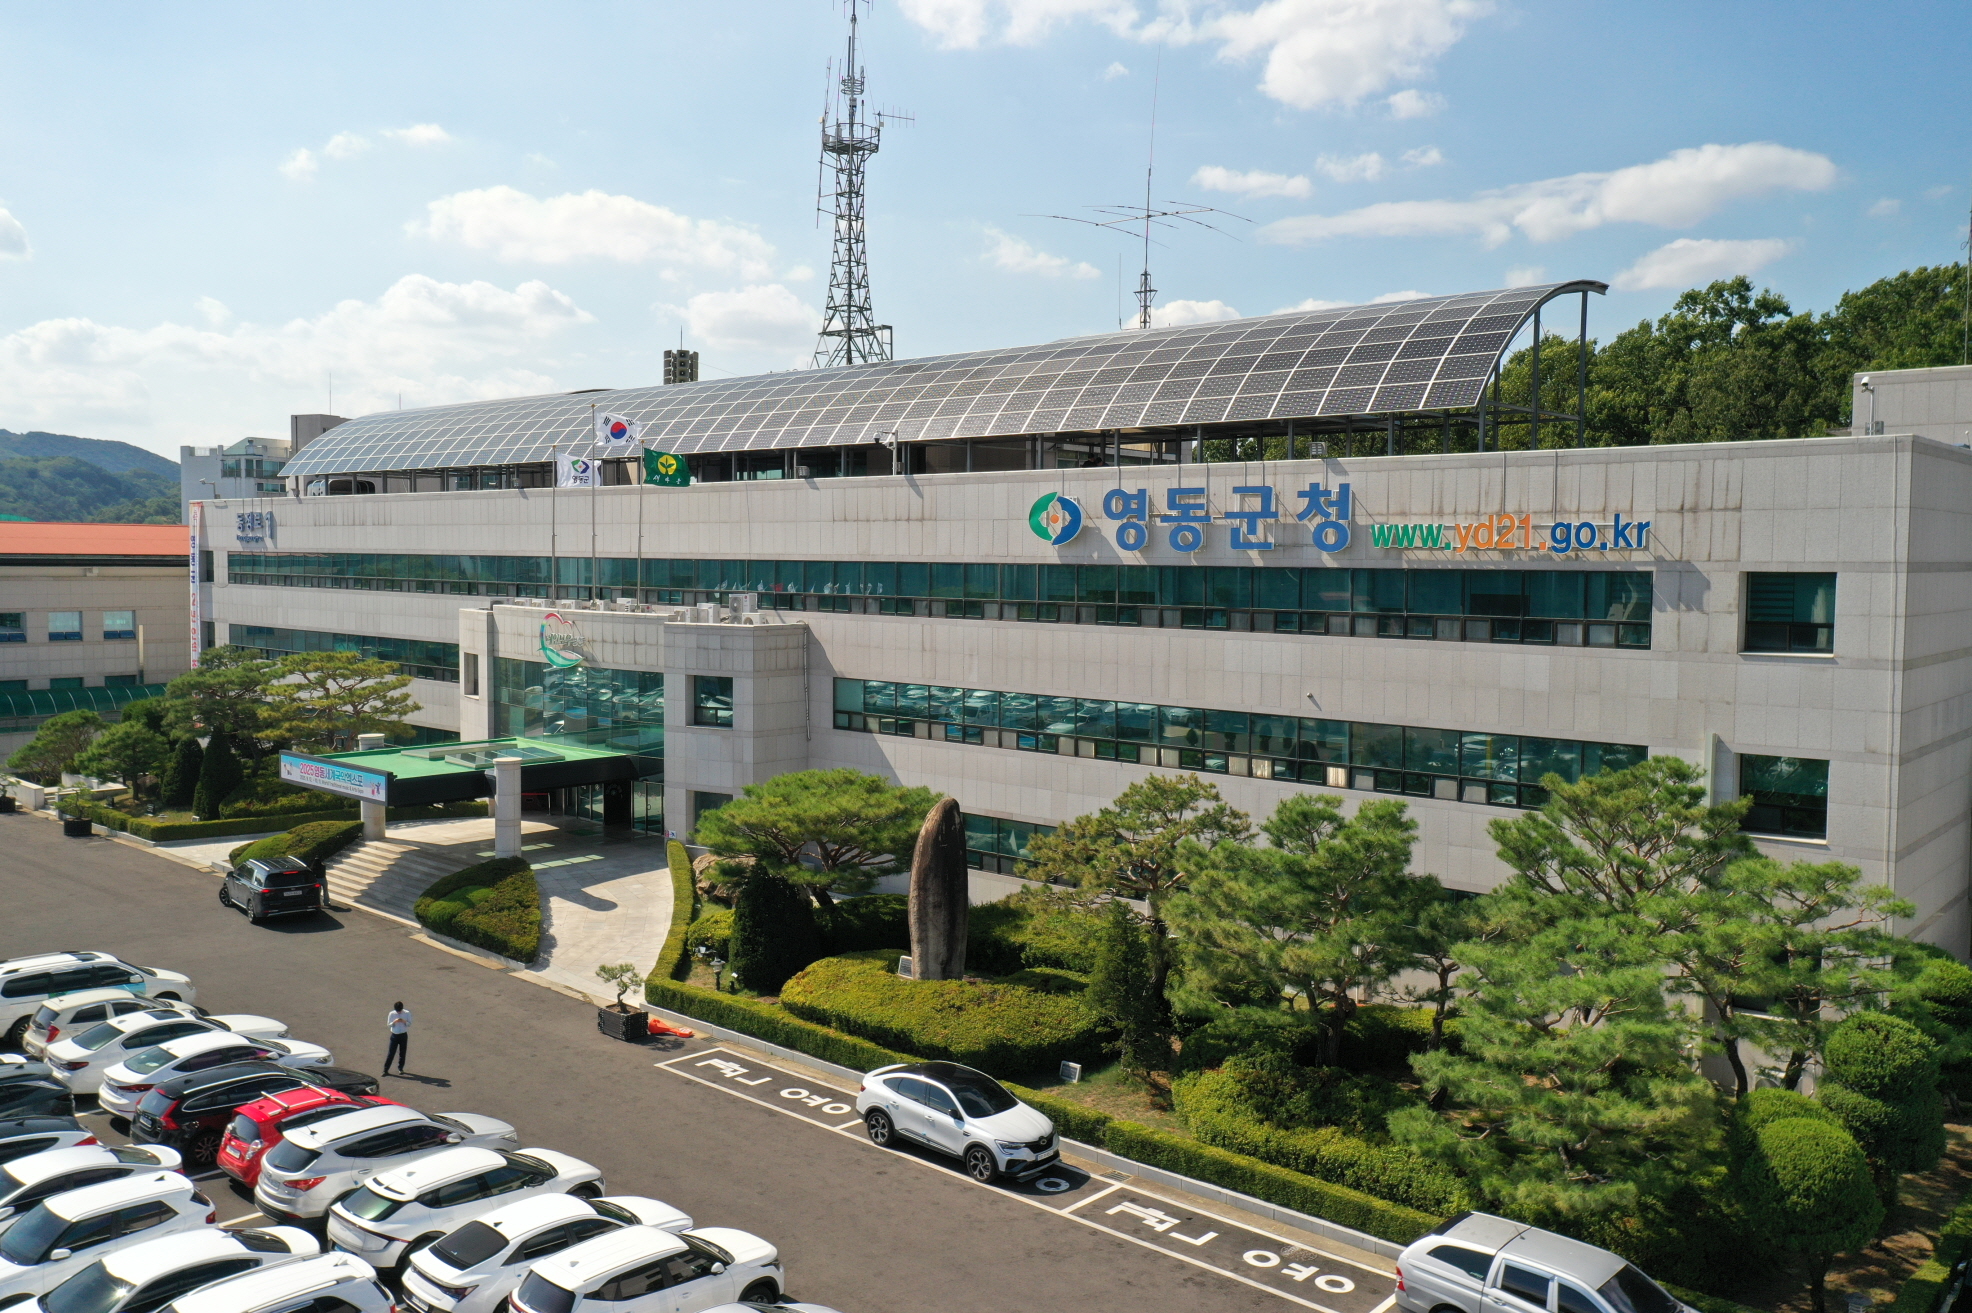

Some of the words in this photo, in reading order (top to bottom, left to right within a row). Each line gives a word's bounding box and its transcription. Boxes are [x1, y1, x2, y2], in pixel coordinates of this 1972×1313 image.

[1103, 482, 1351, 553] 영동군청
[1370, 512, 1651, 554] www.yd21.go.kr
[1105, 1201, 1355, 1294] 관용
